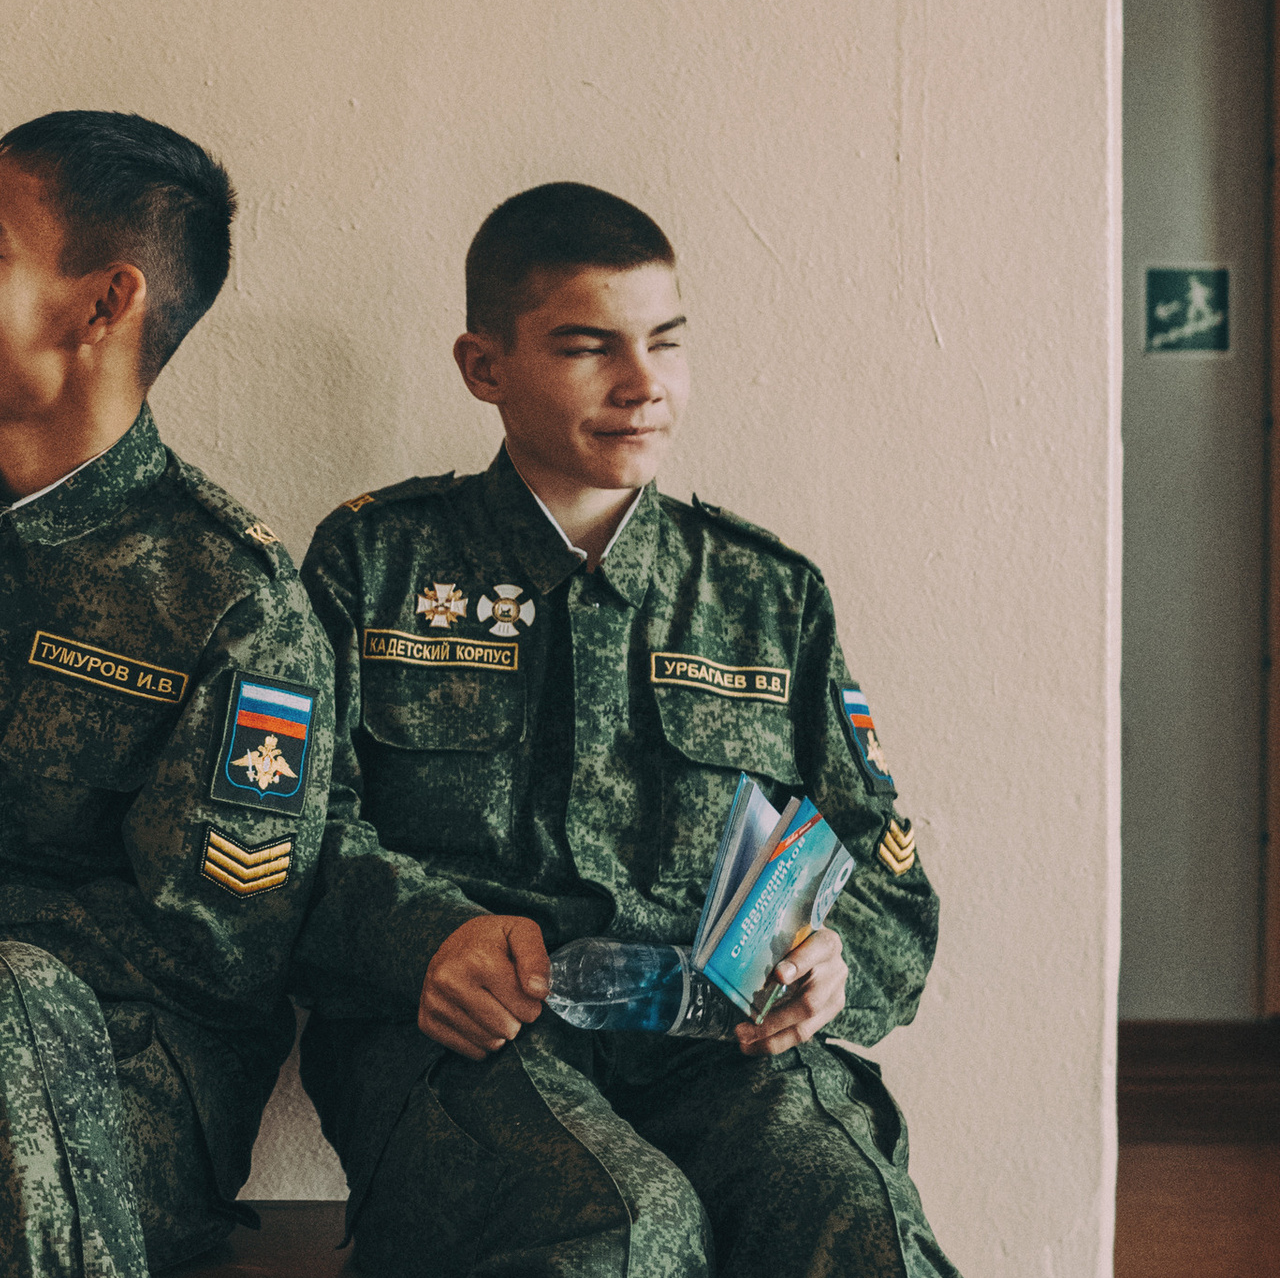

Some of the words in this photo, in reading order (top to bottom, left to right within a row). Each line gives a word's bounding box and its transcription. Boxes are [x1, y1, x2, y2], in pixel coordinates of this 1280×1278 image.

[369, 636, 450, 661] КАДЕТСКИЙ
[455, 645, 512, 665] КОРПУС
[40, 641, 130, 682] ТУМУРОВ
[136, 671, 177, 695] И.В.
[664, 660, 747, 689] УРБАГАЕВ
[755, 674, 784, 694] В.В.
